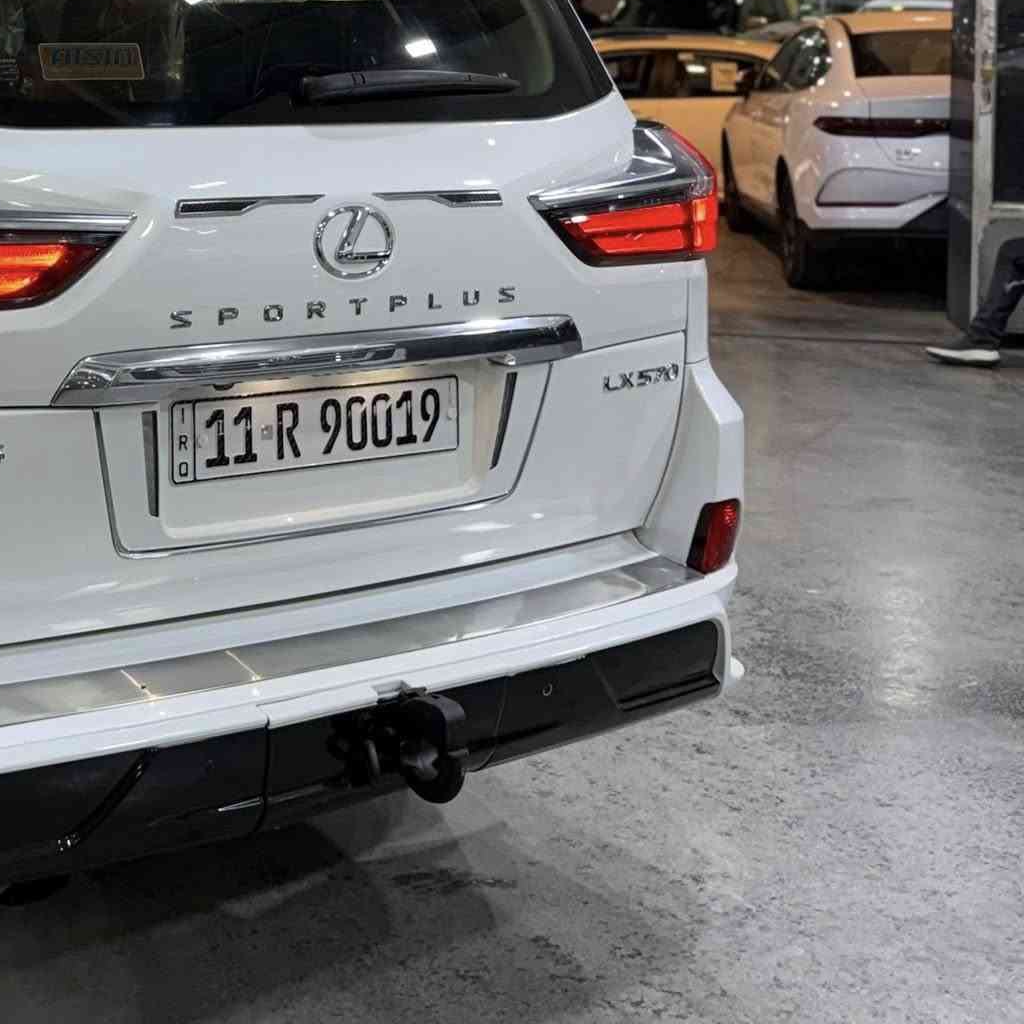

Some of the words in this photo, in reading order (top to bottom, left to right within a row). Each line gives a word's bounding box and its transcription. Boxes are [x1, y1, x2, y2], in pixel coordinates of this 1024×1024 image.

[205, 406, 258, 468] 11
[276, 402, 301, 460] R
[320, 388, 441, 455] 90019
